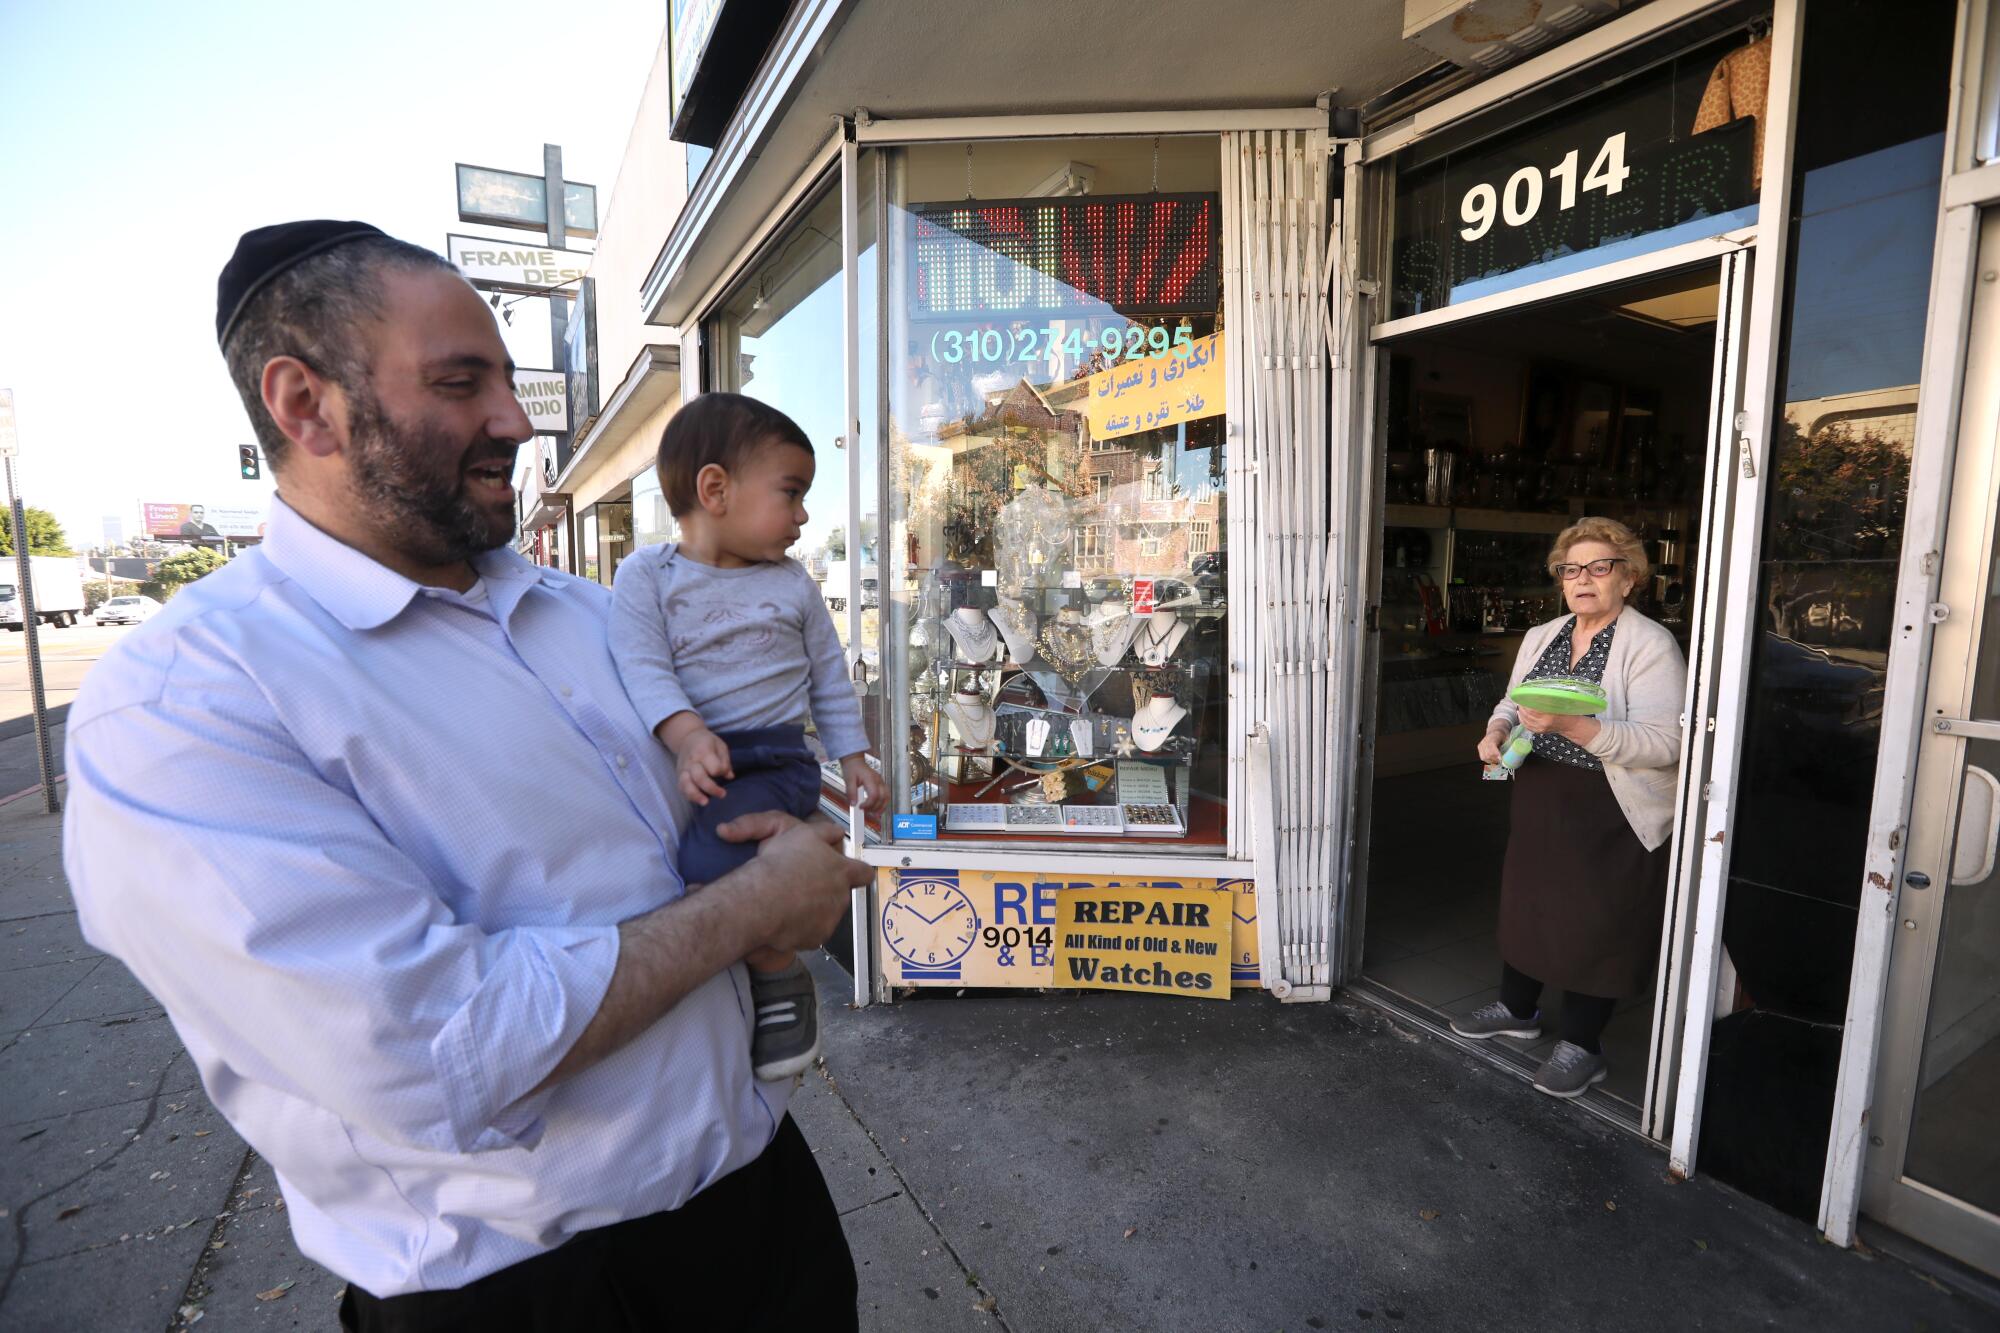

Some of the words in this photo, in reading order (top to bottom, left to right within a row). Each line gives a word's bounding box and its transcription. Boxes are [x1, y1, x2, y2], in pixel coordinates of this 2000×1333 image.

[1459, 131, 1631, 242] 9014
[460, 251, 556, 267] FRAME
[931, 326, 1194, 363] (310)274-9295
[924, 884, 935, 895] 12
[1242, 883, 1254, 894] 12
[966, 918, 973, 929] 3
[1073, 901, 1210, 928] REPAIR
[887, 919, 893, 930] 9
[983, 927, 1054, 948] 9014
[1065, 934, 1085, 949] All
[1088, 935, 1122, 950] Kind
[1125, 937, 1141, 951] of
[1143, 937, 1168, 952] Old
[1171, 940, 1182, 954] &
[1185, 939, 1218, 956] New
[928, 952, 935, 963] 6
[997, 945, 1015, 966] &
[1243, 952, 1250, 964] 6
[1068, 957, 1213, 990] Watches
